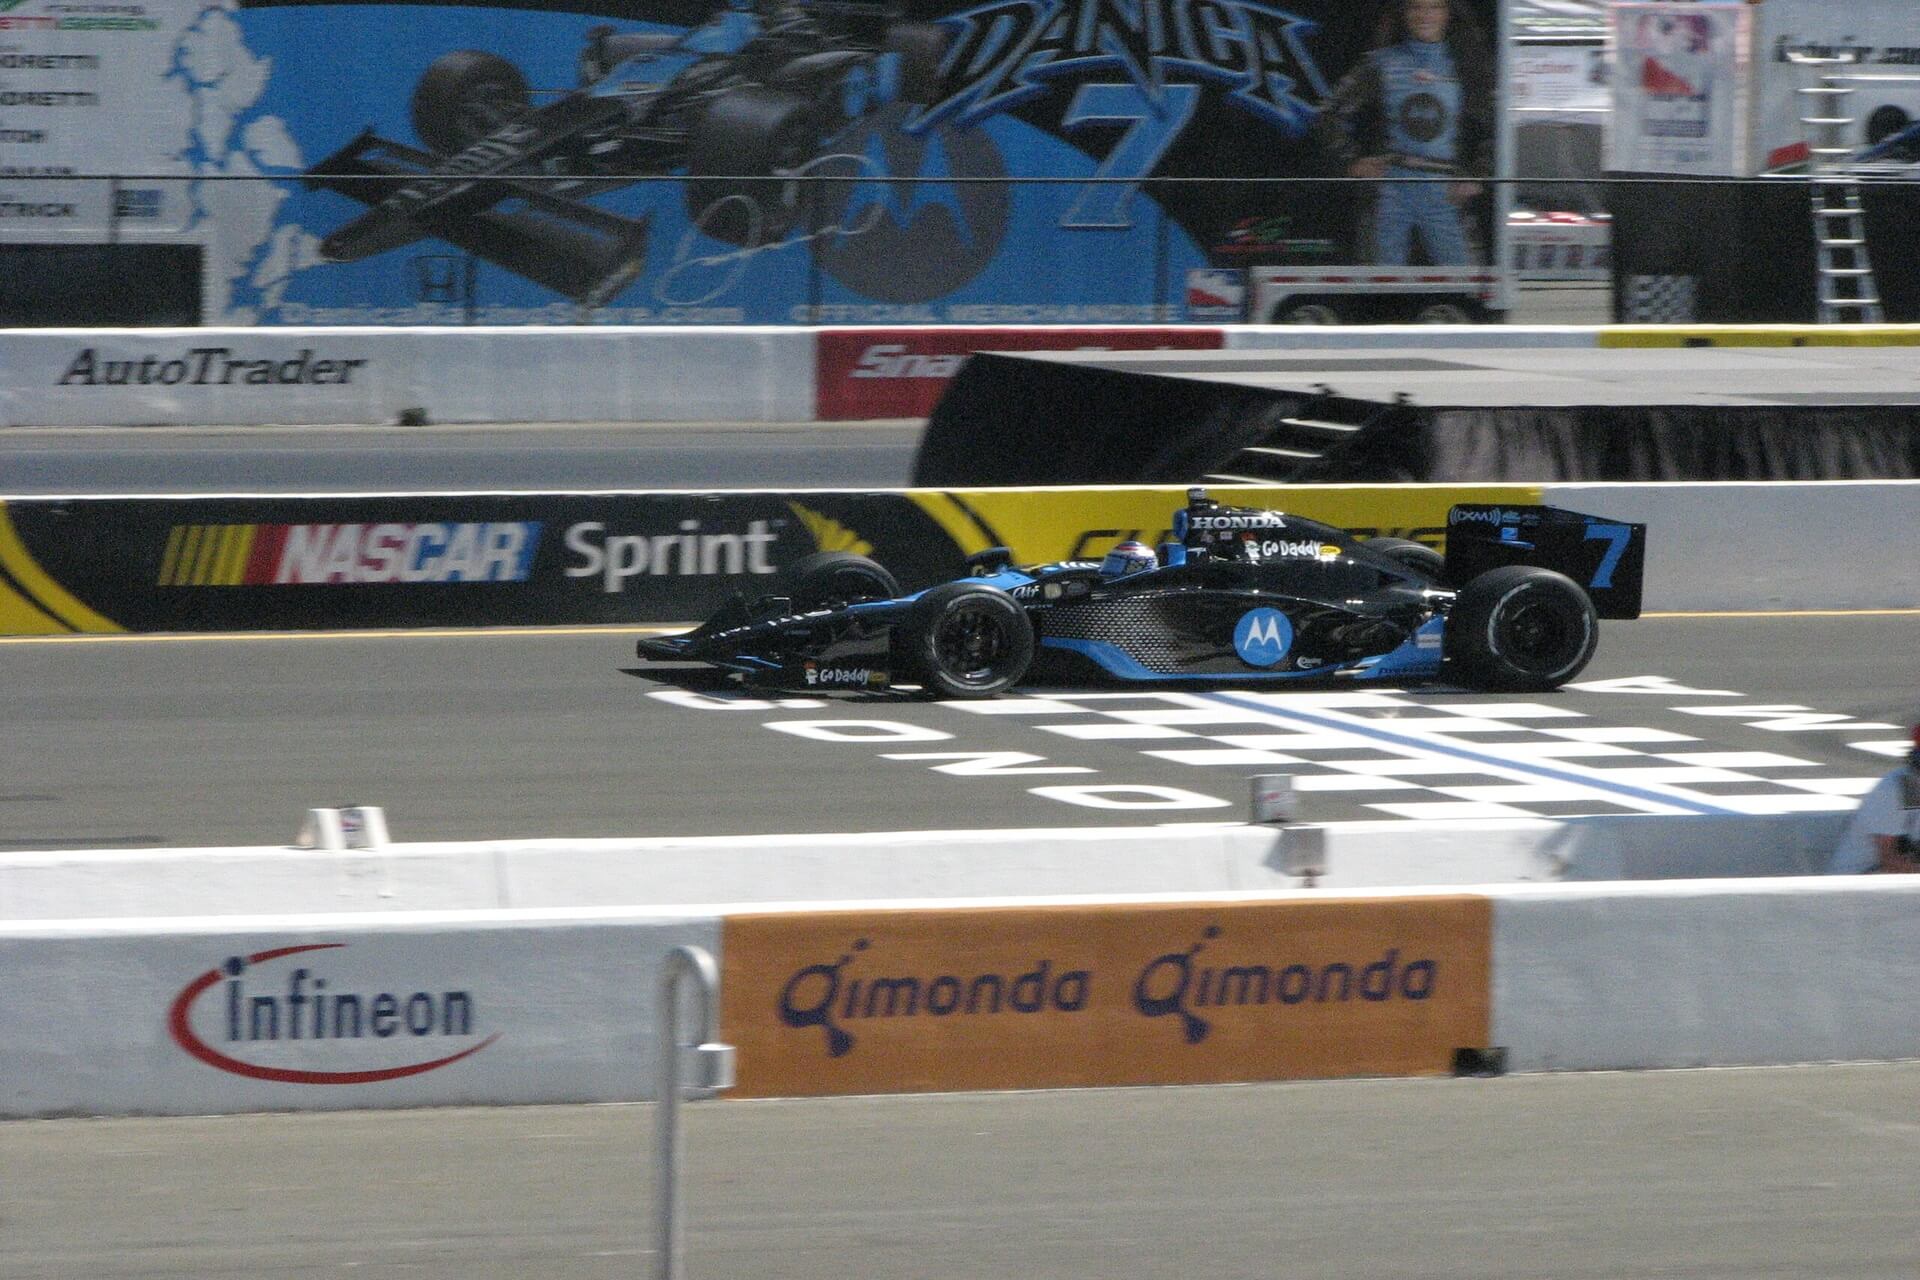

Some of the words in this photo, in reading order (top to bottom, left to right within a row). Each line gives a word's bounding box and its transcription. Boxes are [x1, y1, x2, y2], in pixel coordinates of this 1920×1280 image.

[1059, 83, 1199, 229] 7
[54, 347, 368, 386] AutoTrader
[852, 344, 964, 378] Sna
[1191, 516, 1287, 529] HONDA
[277, 522, 526, 583] NASCAR
[564, 519, 777, 593] Sprint
[1583, 523, 1632, 588] 7
